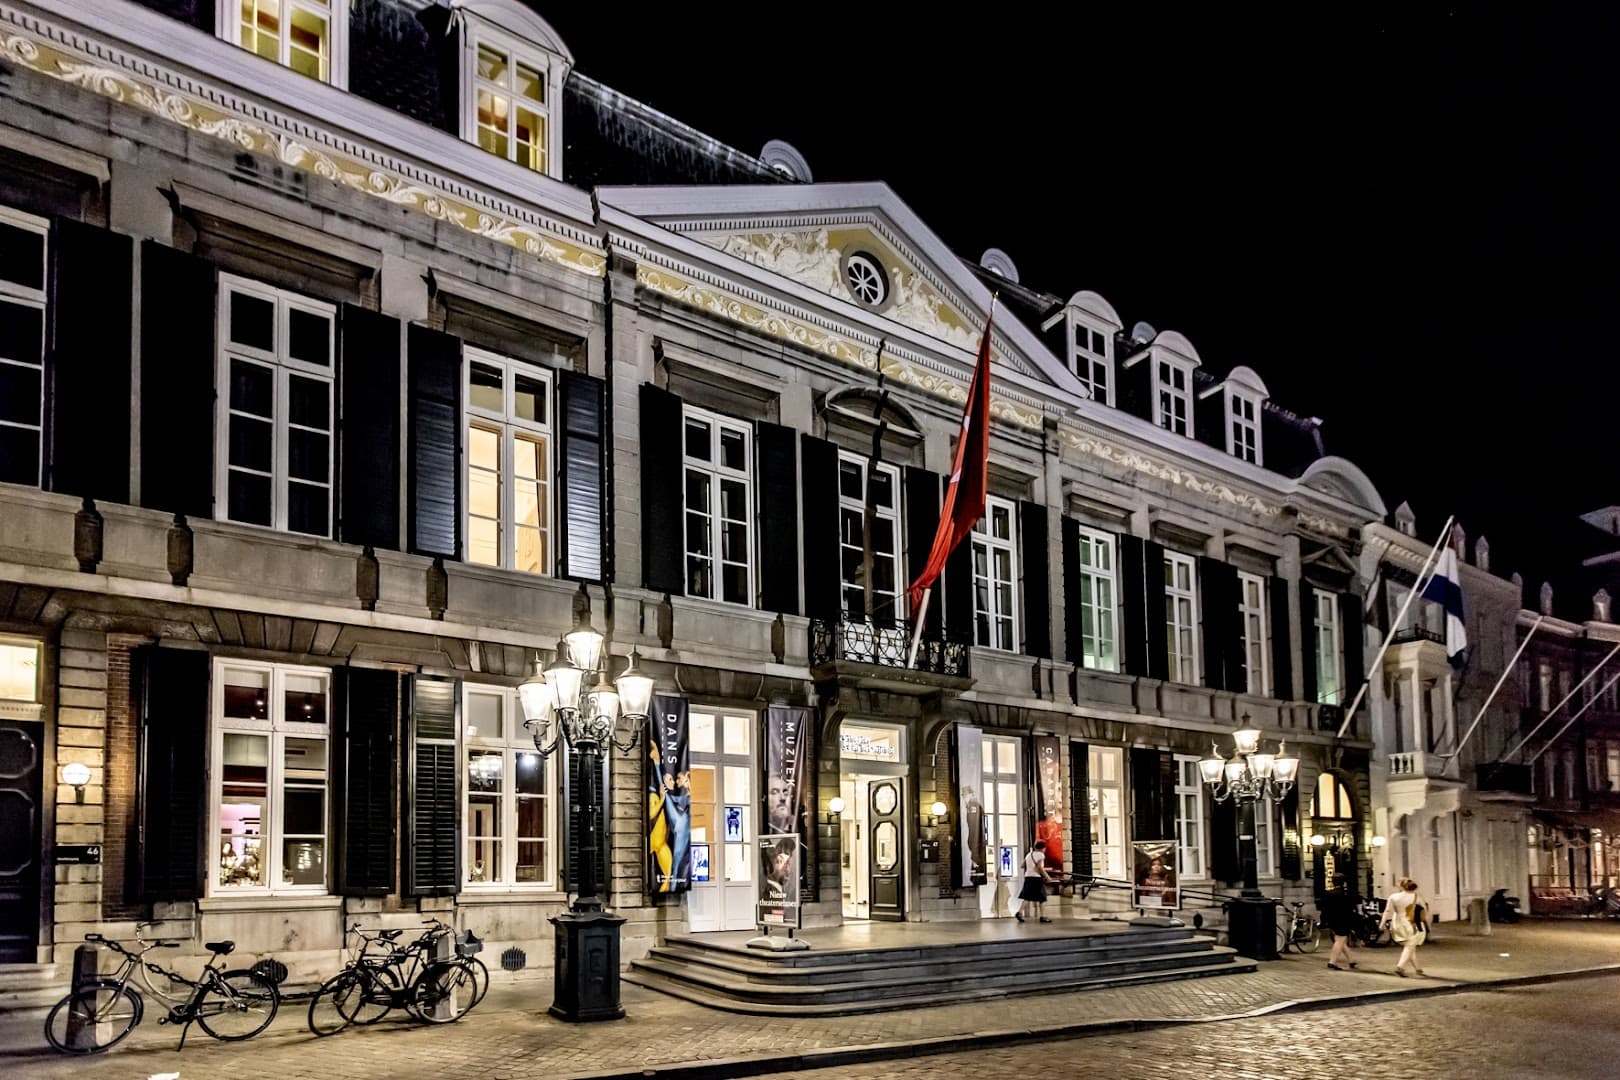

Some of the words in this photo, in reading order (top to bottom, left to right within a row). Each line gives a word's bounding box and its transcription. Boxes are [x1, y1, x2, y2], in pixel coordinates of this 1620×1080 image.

[667, 714, 678, 764] DANS
[785, 722, 795, 787] MUZIEK
[86, 847, 99, 855] 46
